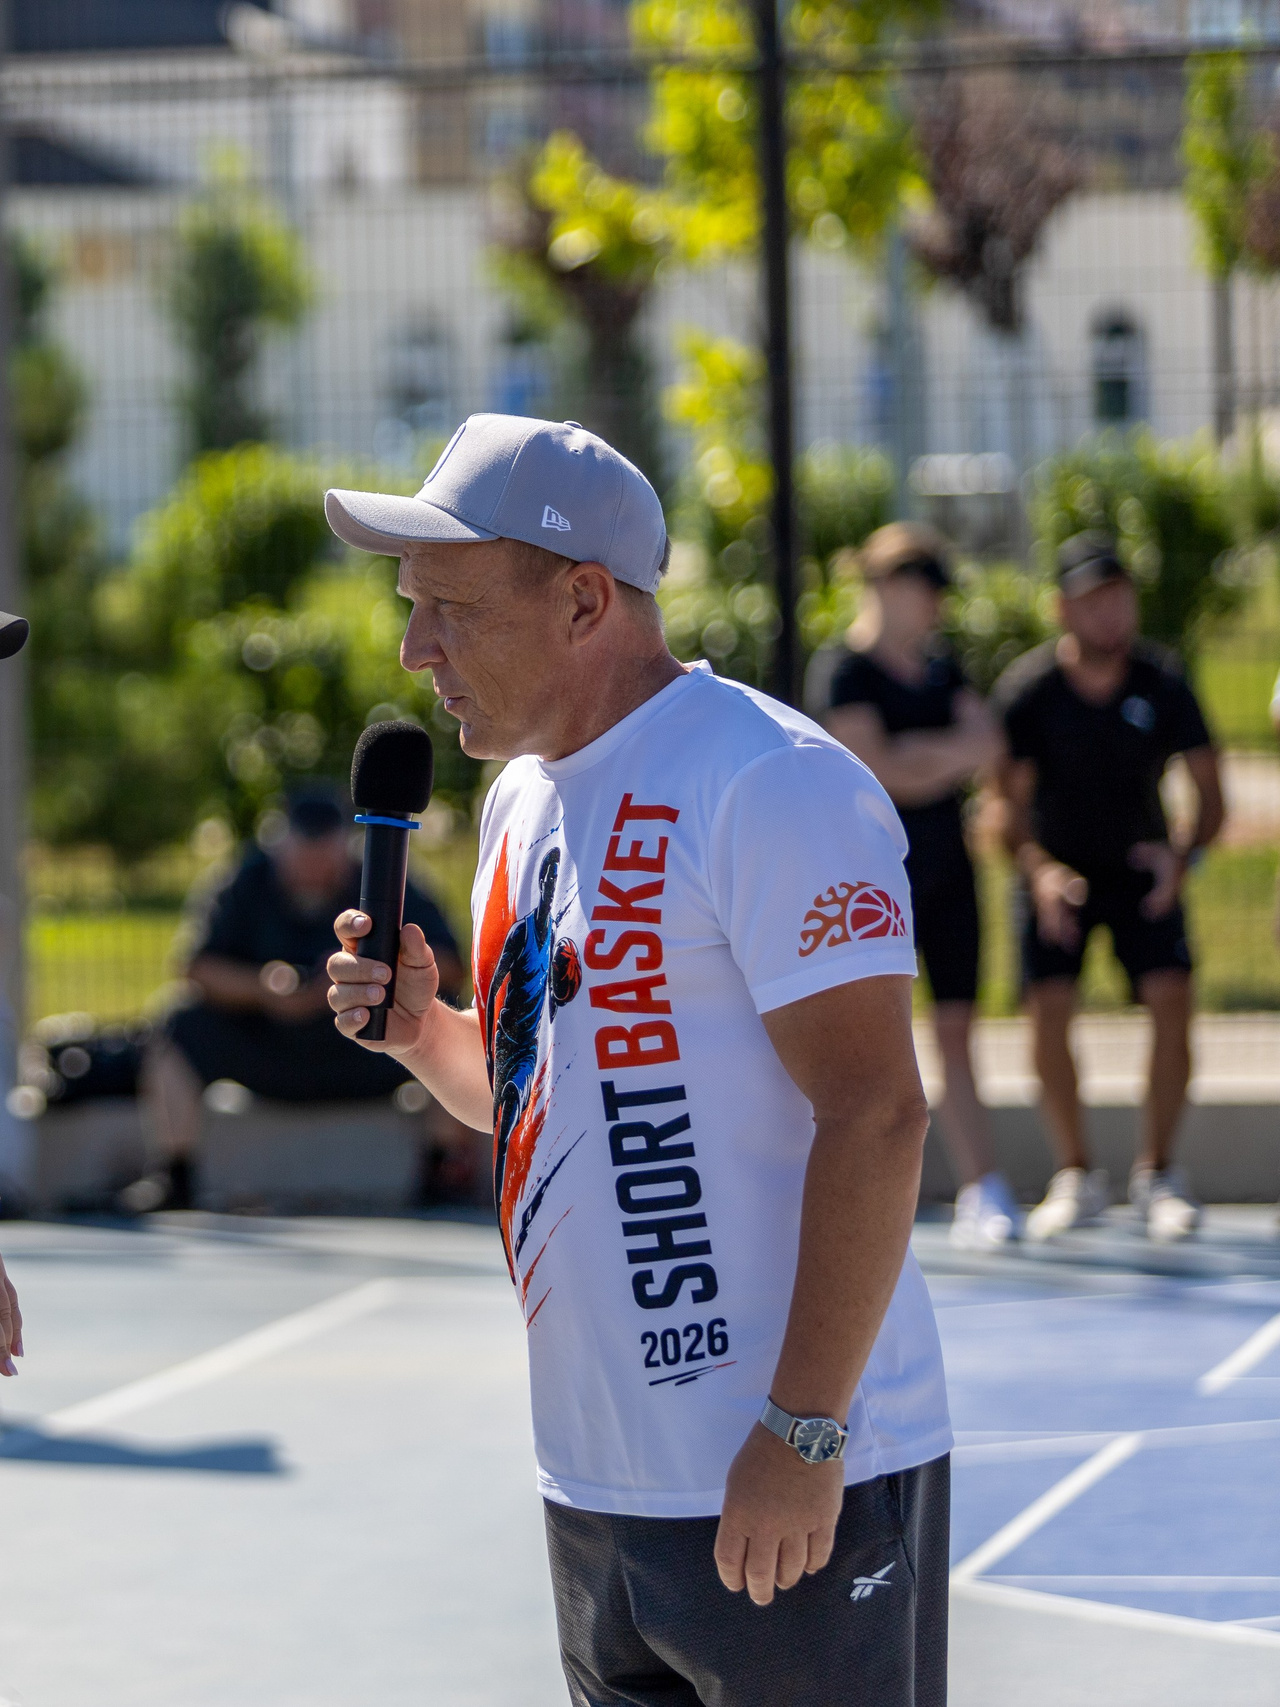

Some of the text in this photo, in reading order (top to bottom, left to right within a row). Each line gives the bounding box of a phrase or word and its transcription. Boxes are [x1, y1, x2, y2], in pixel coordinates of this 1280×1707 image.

[584, 793, 718, 1310] SHORT BASKET
[640, 1317, 729, 1369] 2026
